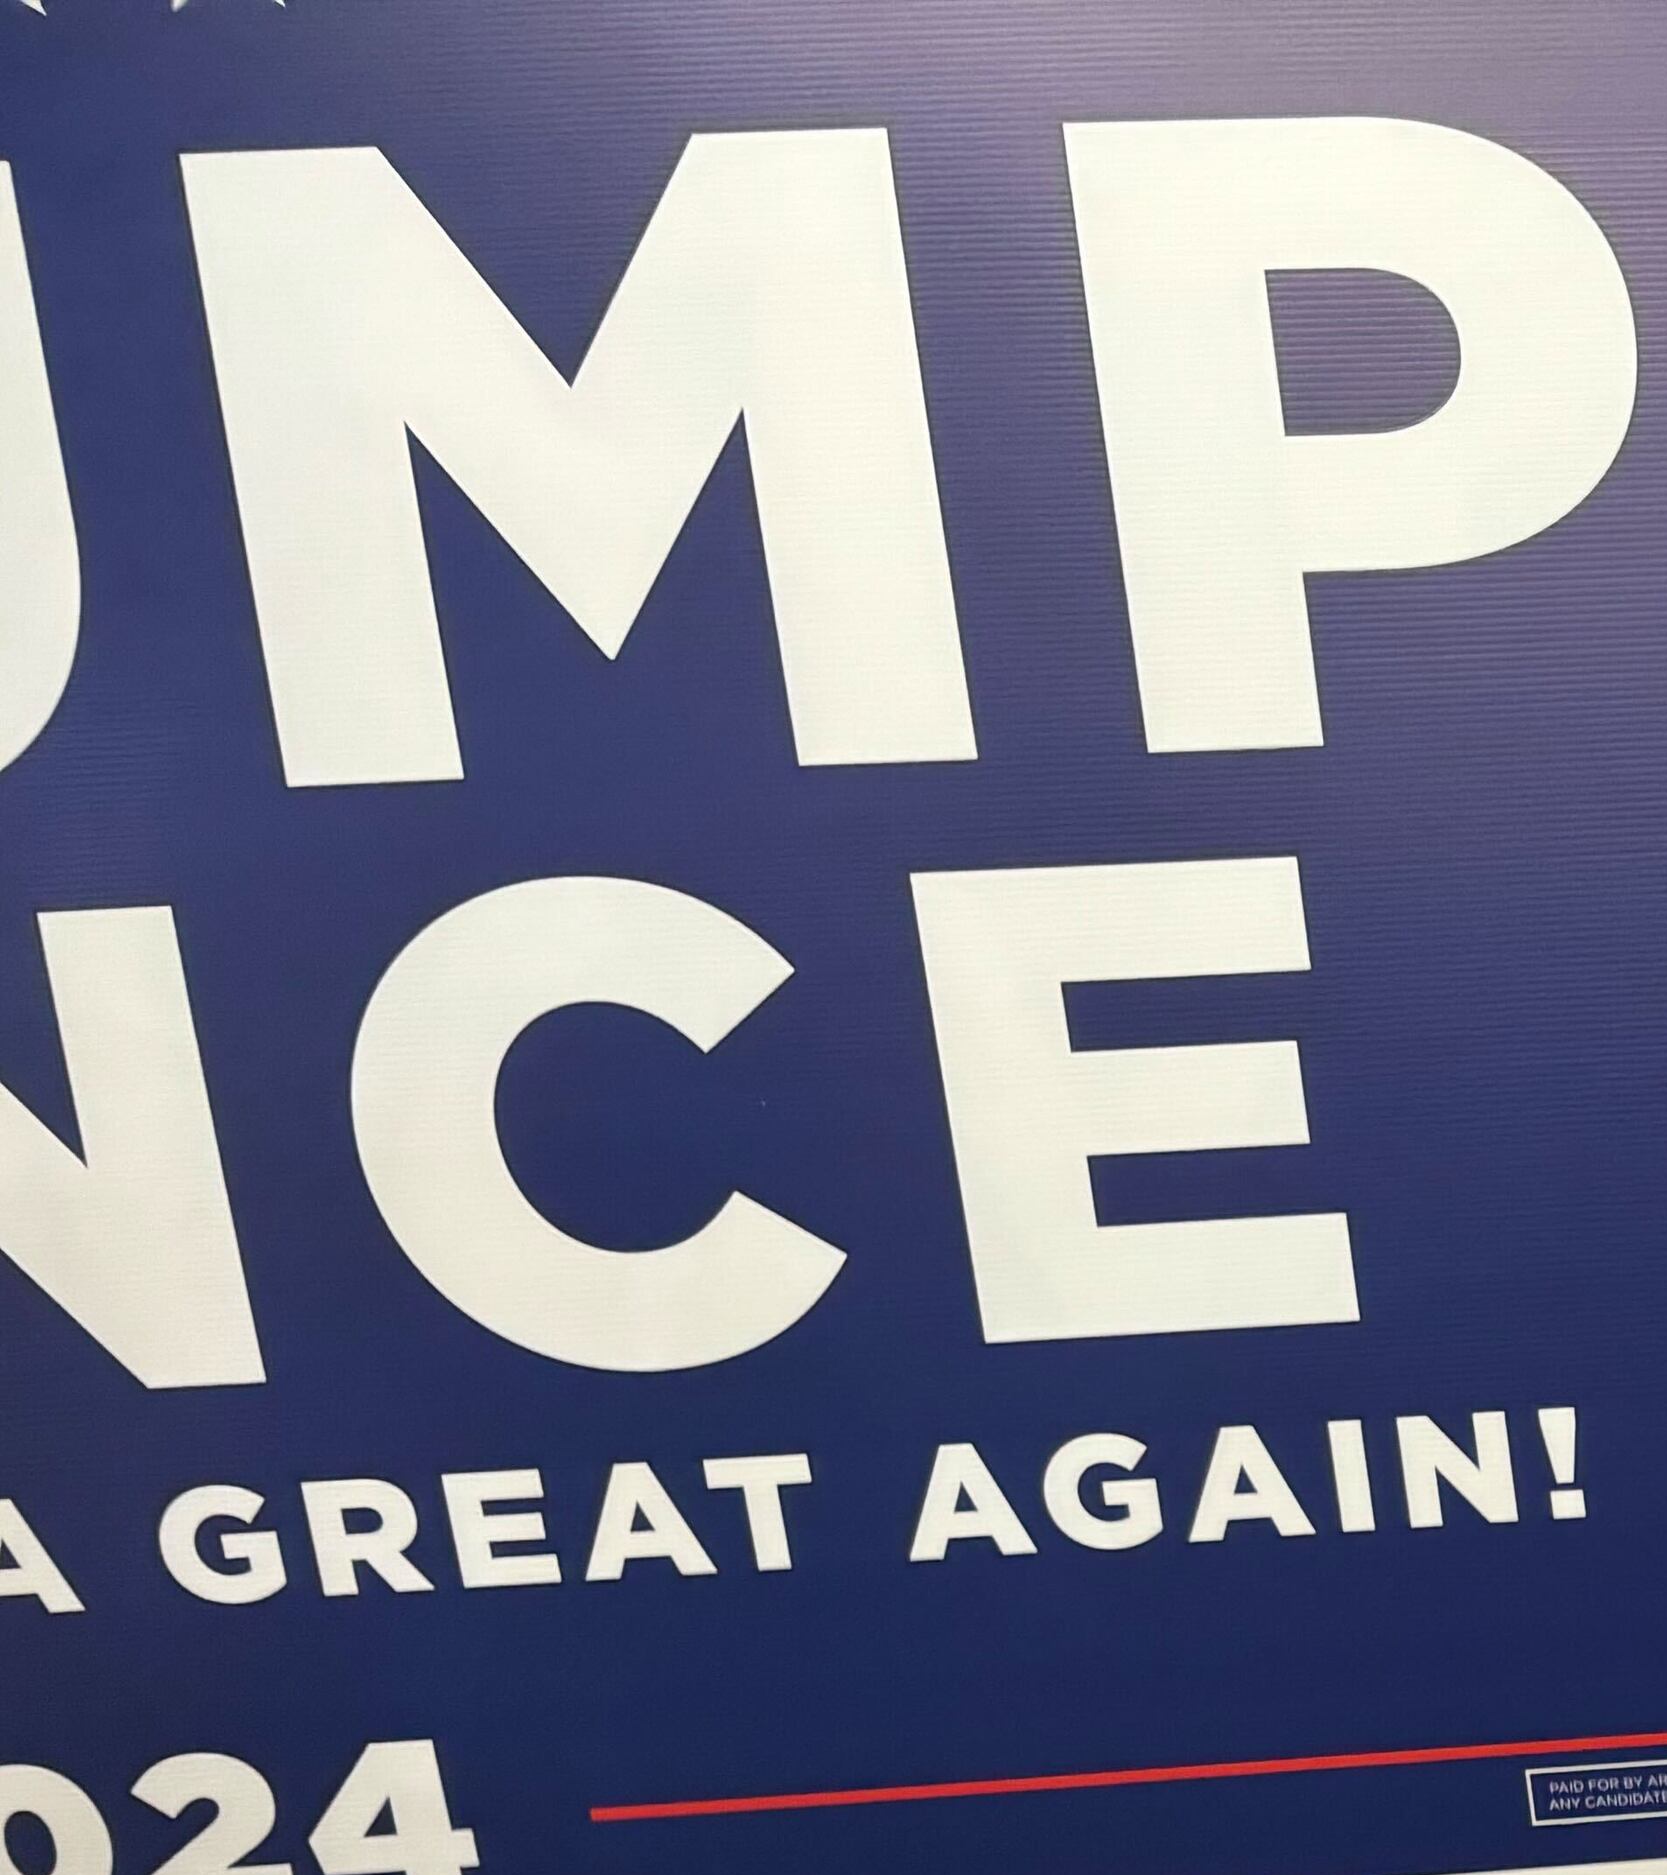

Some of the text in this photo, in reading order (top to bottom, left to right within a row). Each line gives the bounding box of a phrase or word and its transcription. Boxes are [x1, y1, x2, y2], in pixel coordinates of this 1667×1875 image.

[158, 1454, 812, 1604] GREAT
[909, 1406, 1588, 1562] AGAIN!
[1549, 1779, 1584, 1795] PAID
[1588, 1776, 1619, 1792] FOR
[1623, 1775, 1643, 1790] BY
[1549, 1797, 1580, 1811] ANY
